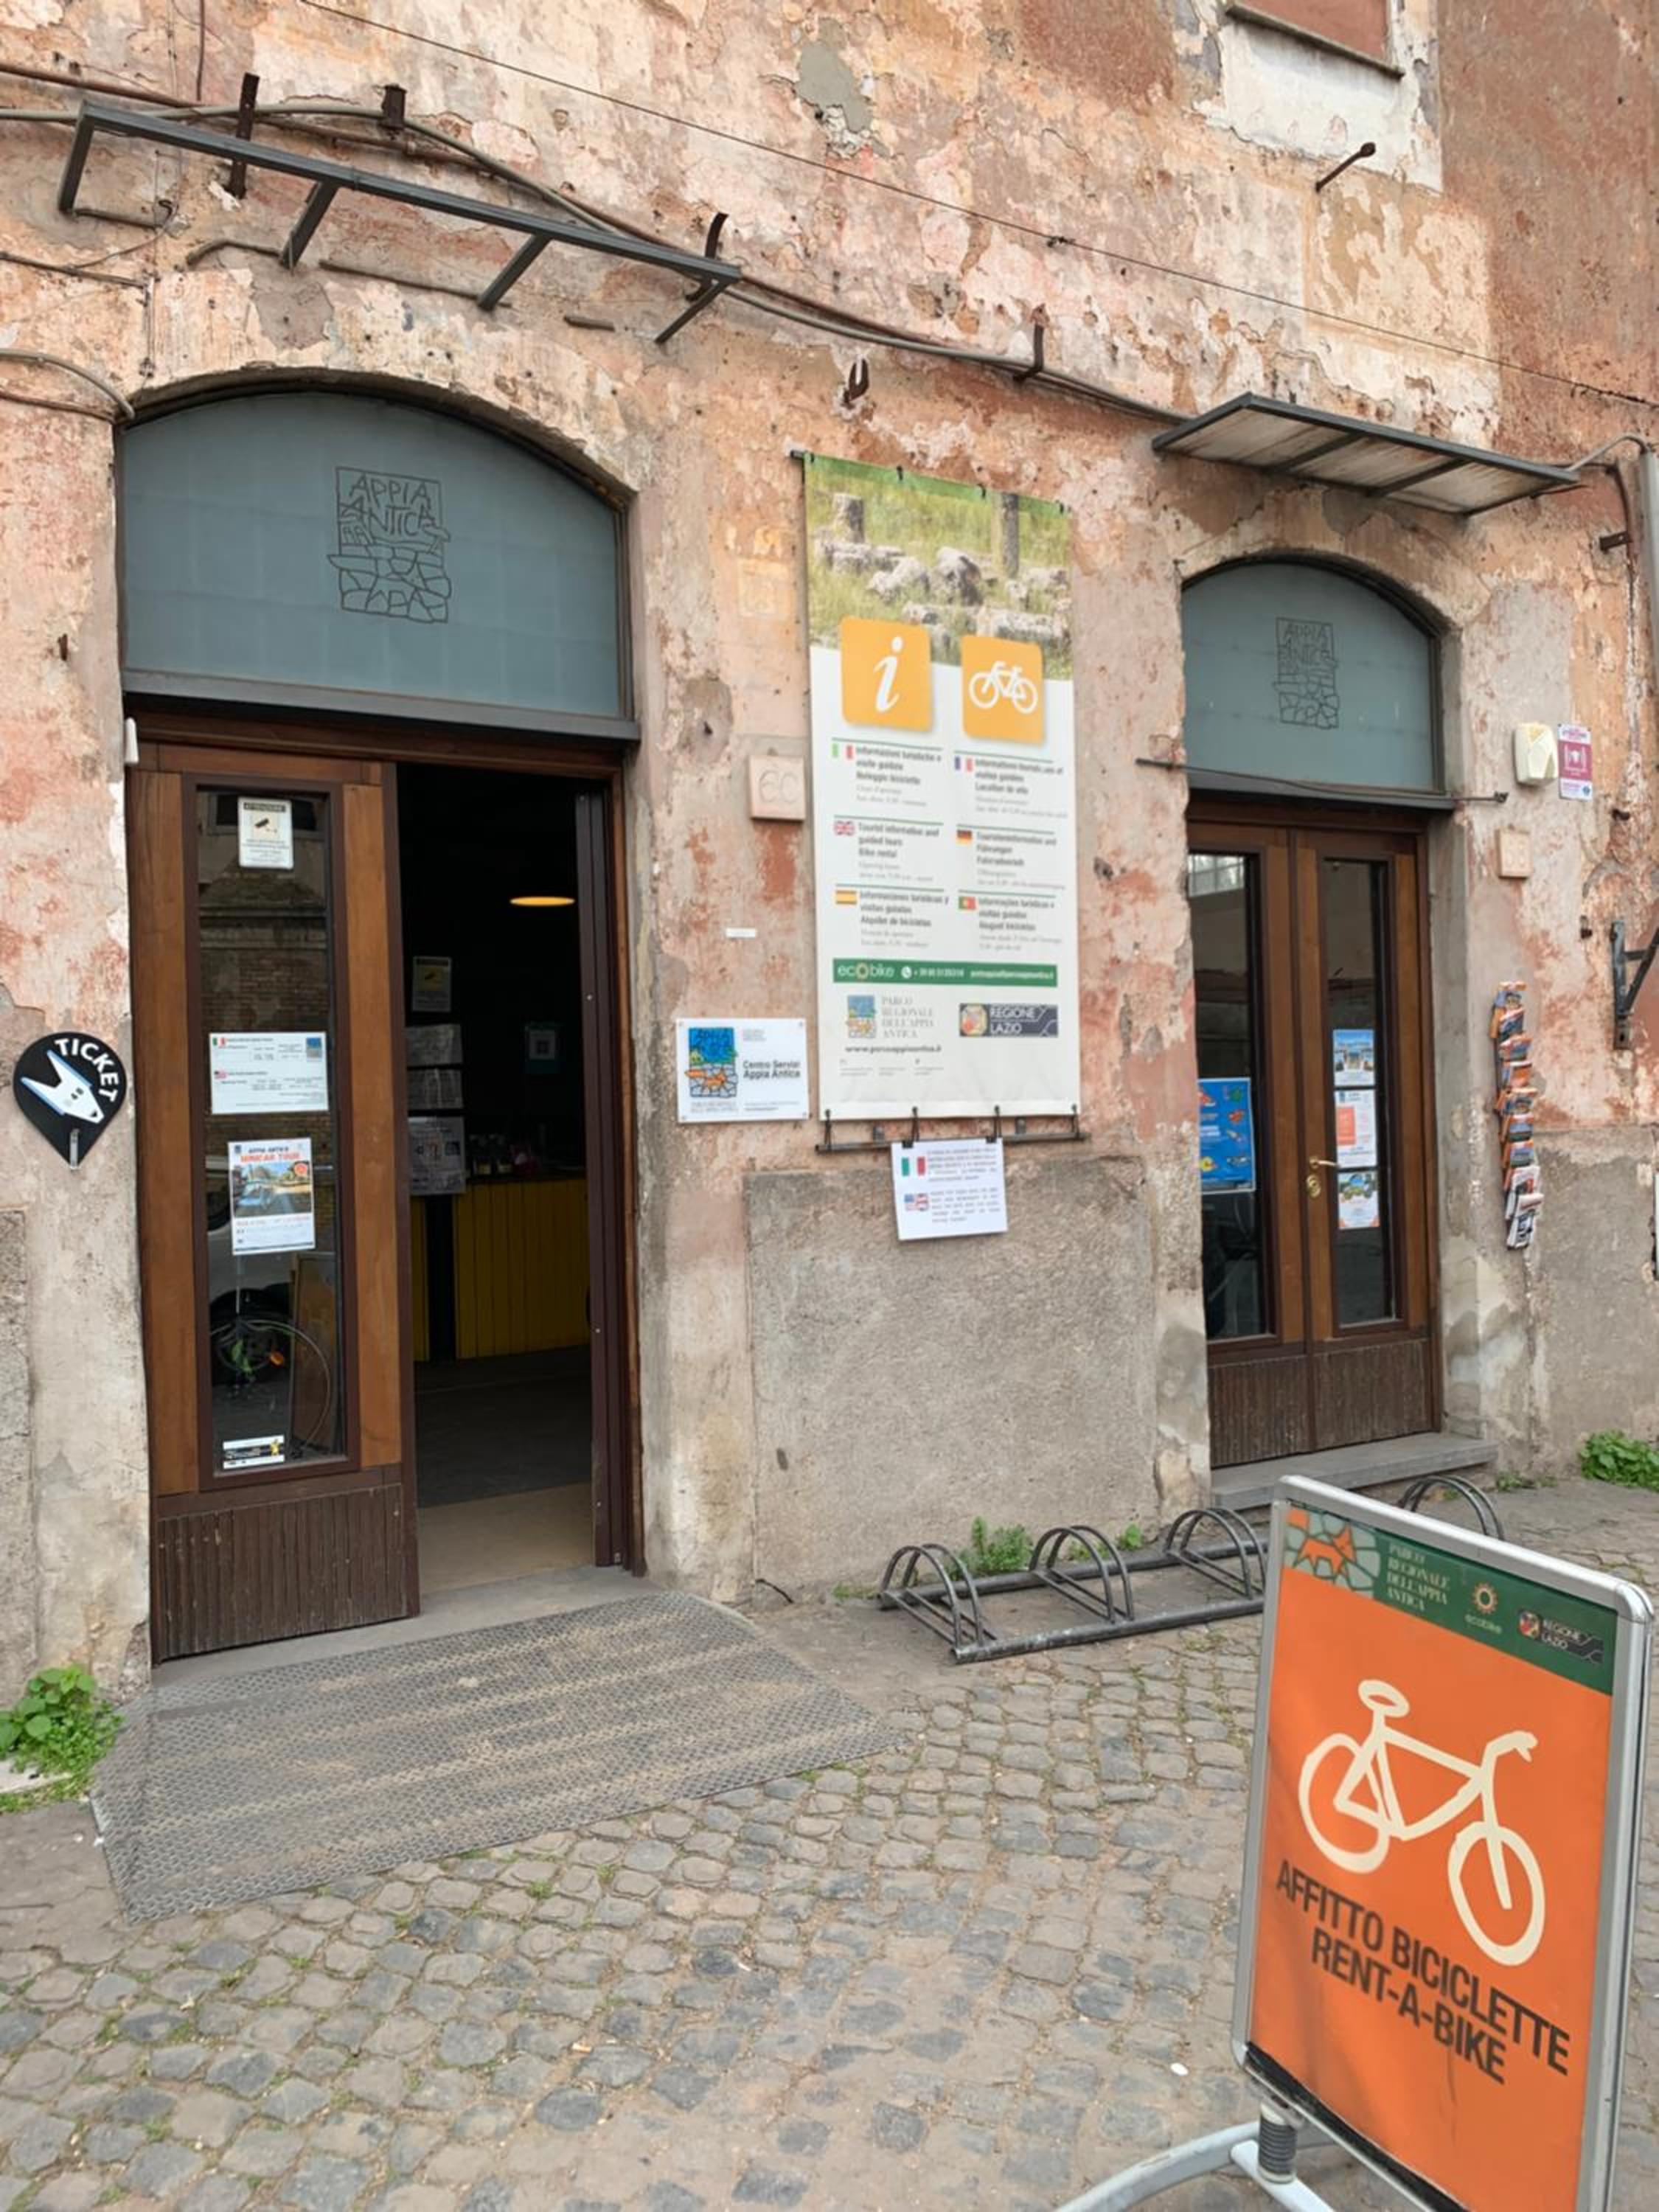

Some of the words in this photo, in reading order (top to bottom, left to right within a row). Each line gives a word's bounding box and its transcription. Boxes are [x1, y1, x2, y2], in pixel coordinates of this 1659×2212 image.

[349, 473, 431, 510] APPIA
[341, 495, 437, 536] ANTICA
[858, 821, 883, 832] Tourist
[858, 847, 875, 858] Bike
[881, 996, 914, 1005] PARCO
[991, 1006, 1036, 1018] REGIONE
[991, 1023, 1022, 1034] LAZIO
[54, 1038, 119, 1103] TICKET
[742, 1060, 771, 1069] Centro
[773, 1060, 801, 1069] Servizi
[742, 1070, 771, 1080] Appia
[772, 1069, 801, 1079] Antica
[1389, 1558, 1450, 1587] REGIONALE
[1387, 1587, 1425, 1610] ANTICA
[1542, 1630, 1569, 1650] LAZIO
[1543, 1618, 1582, 1644] REGIONE
[1276, 1859, 1385, 1952] AFFITTO
[1391, 1925, 1571, 2078] BICICLETTE
[1312, 1926, 1507, 2086] RENT-A-BIKE
